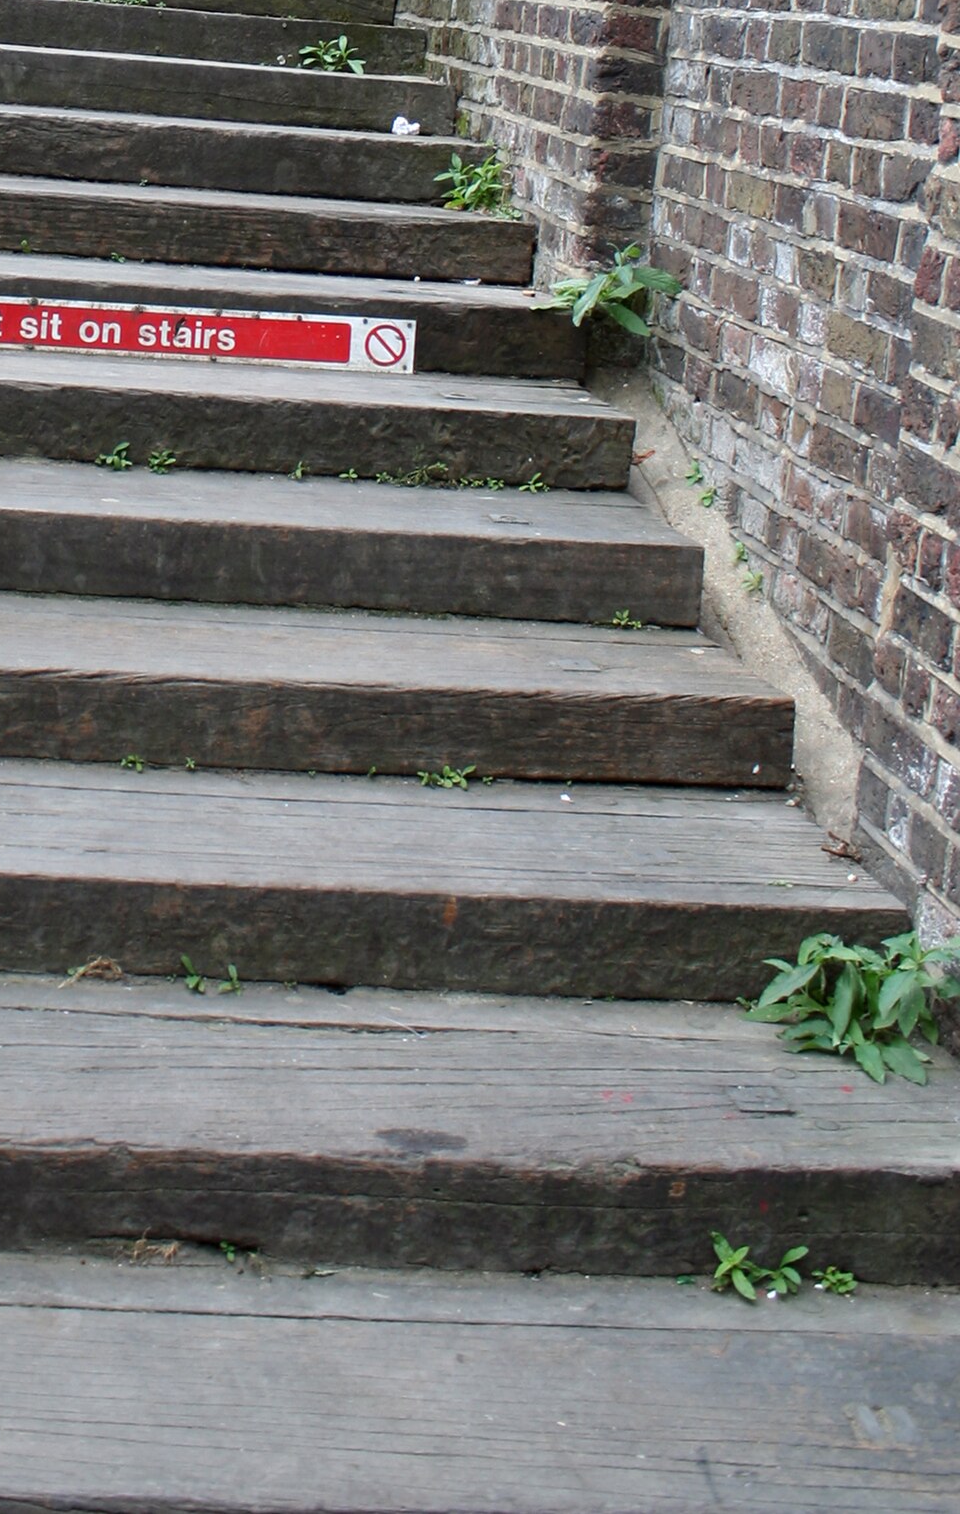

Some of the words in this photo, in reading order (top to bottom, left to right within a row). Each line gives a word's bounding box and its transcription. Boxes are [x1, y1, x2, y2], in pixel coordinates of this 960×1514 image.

[19, 311, 62, 340] sit
[79, 320, 121, 344] on
[138, 320, 236, 351] stairs
